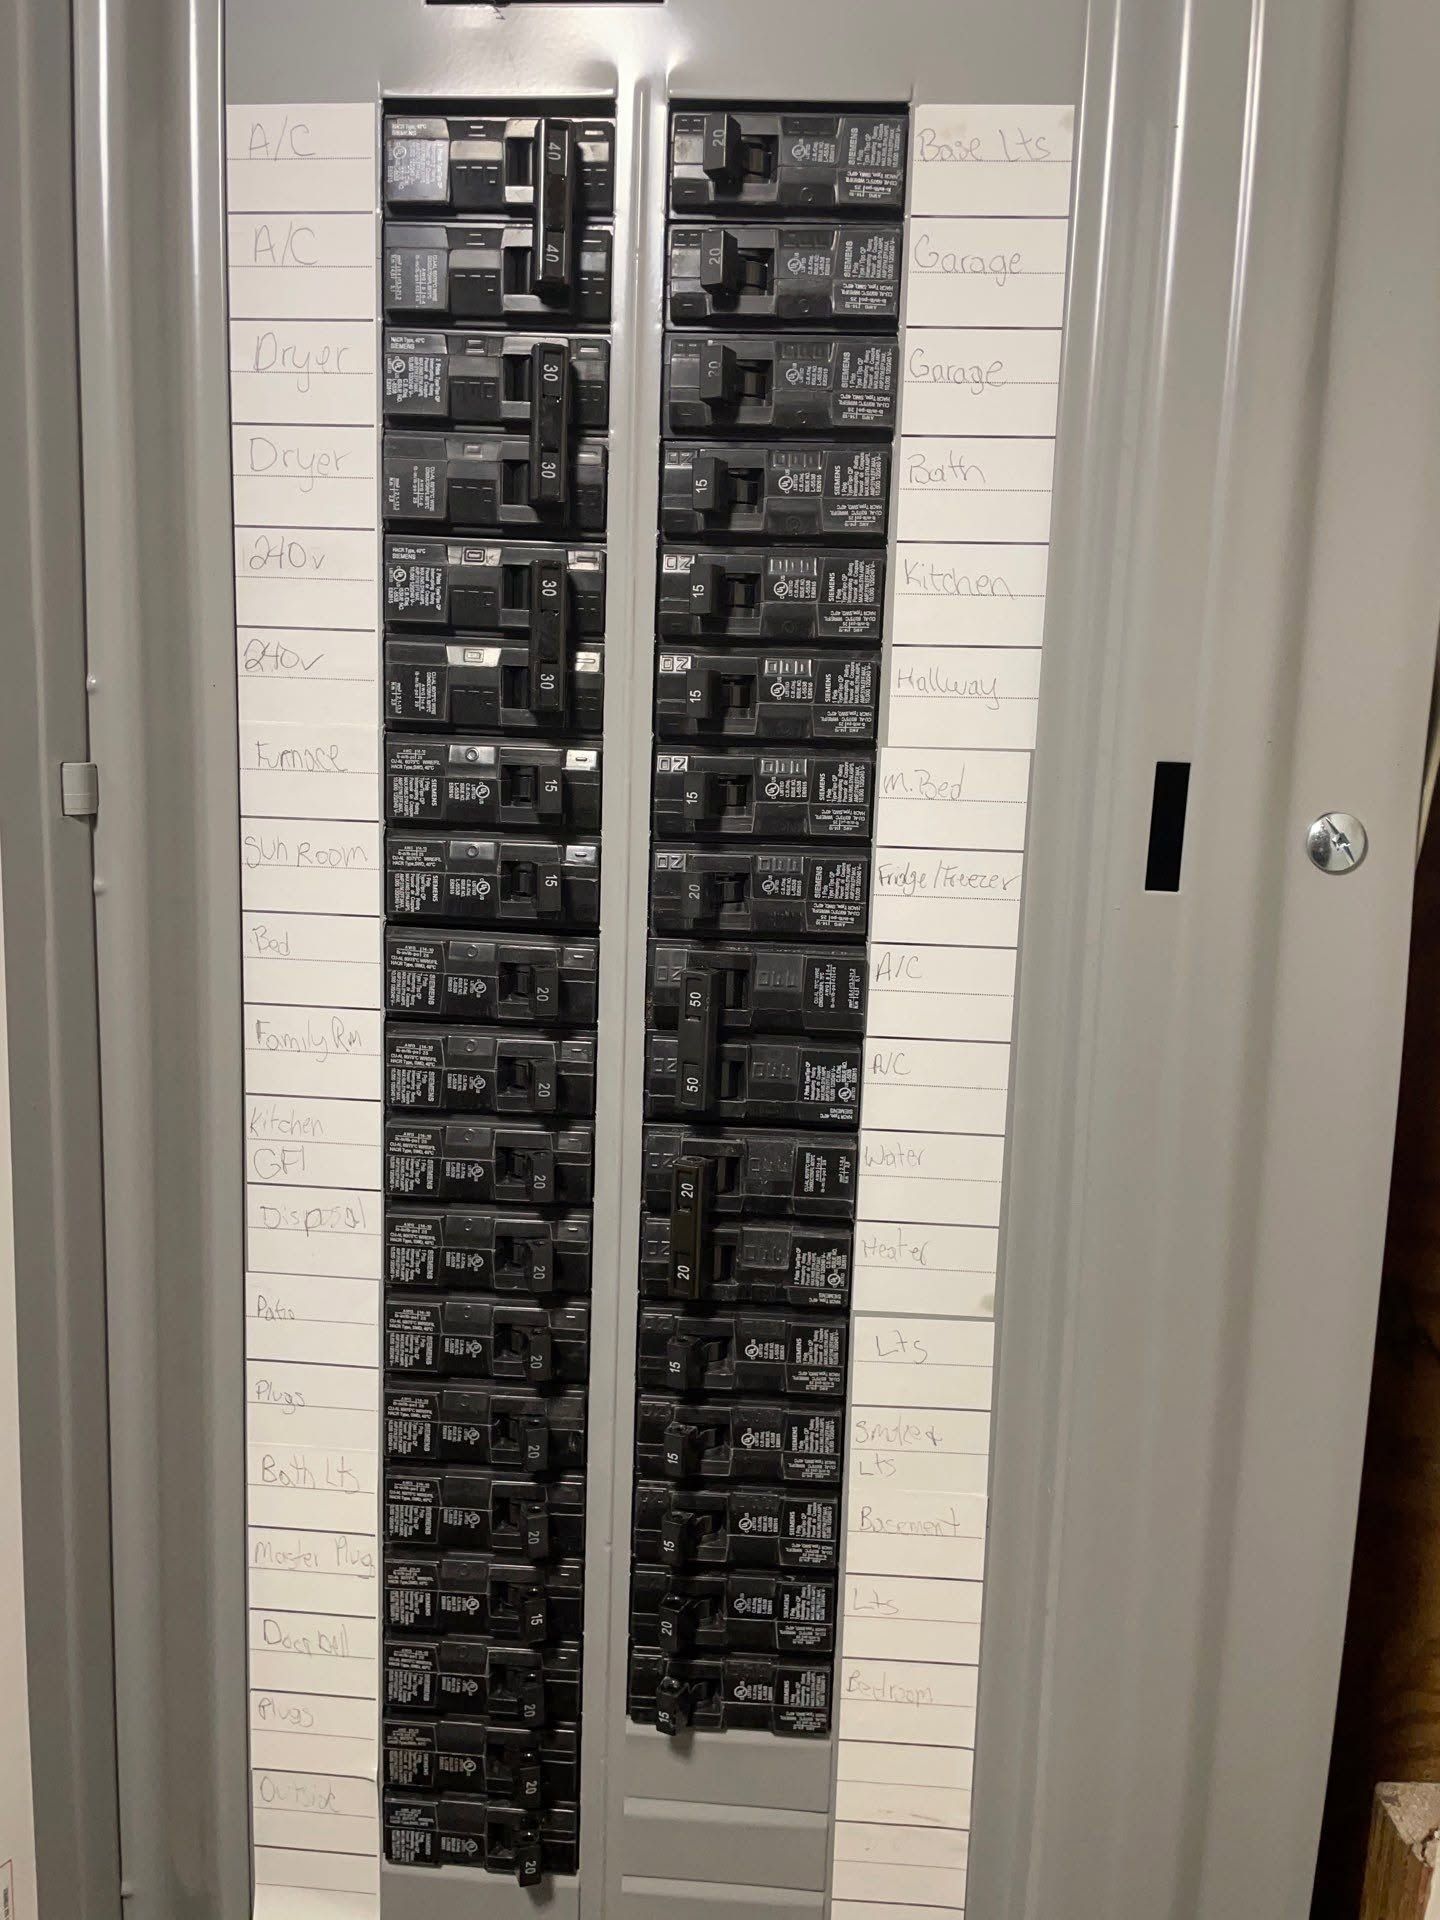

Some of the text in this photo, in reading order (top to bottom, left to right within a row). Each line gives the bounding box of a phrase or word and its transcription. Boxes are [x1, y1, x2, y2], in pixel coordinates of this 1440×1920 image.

[249, 115, 316, 161] A/C
[712, 130, 725, 148] 20
[546, 142, 562, 161] 40
[848, 128, 858, 166] SIEMENS
[254, 220, 318, 266] A/C
[545, 244, 560, 263] 40
[709, 248, 722, 266] 20
[843, 241, 852, 278] SIEMENS
[913, 234, 1022, 287] Garage
[253, 332, 349, 392] Dryer
[708, 361, 721, 378] 20
[840, 352, 850, 389] SIEMENS
[544, 364, 558, 382] 30
[909, 348, 1006, 395] Garage
[249, 437, 351, 493] Dryer
[541, 462, 556, 479] 30
[907, 450, 986, 484] Bath
[696, 479, 708, 494] 15
[904, 558, 1014, 600] Kitchen
[542, 580, 557, 597] 30
[692, 584, 704, 598] 15
[540, 674, 555, 690] 30
[897, 667, 1000, 710] Hallway
[690, 690, 702, 704] 15
[545, 780, 558, 793] 15
[686, 792, 698, 804] 15
[545, 874, 558, 887] 15
[814, 866, 823, 899] SIEMENS
[688, 884, 700, 900] 20
[250, 925, 291, 957] Bed
[875, 951, 923, 981] A/C
[537, 988, 550, 1002] 20
[690, 992, 702, 1008] 50
[255, 1019, 329, 1063] Family
[872, 1052, 912, 1075] A/C
[538, 1083, 550, 1098] 20
[686, 1077, 698, 1093] 50
[249, 1106, 325, 1138] Kitchen
[863, 1144, 925, 1169] Water
[534, 1175, 546, 1190] 20
[681, 1183, 694, 1198] 20
[862, 1228, 929, 1266] Heater
[533, 1266, 546, 1280] 20
[677, 1265, 690, 1280] 20
[530, 1355, 542, 1370] 20
[669, 1361, 681, 1374] 15
[528, 1445, 540, 1459] 20
[667, 1452, 679, 1464] 15
[528, 1530, 540, 1545] 20
[664, 1540, 675, 1552] 15
[530, 1613, 543, 1626] 15
[662, 1621, 673, 1636] 20
